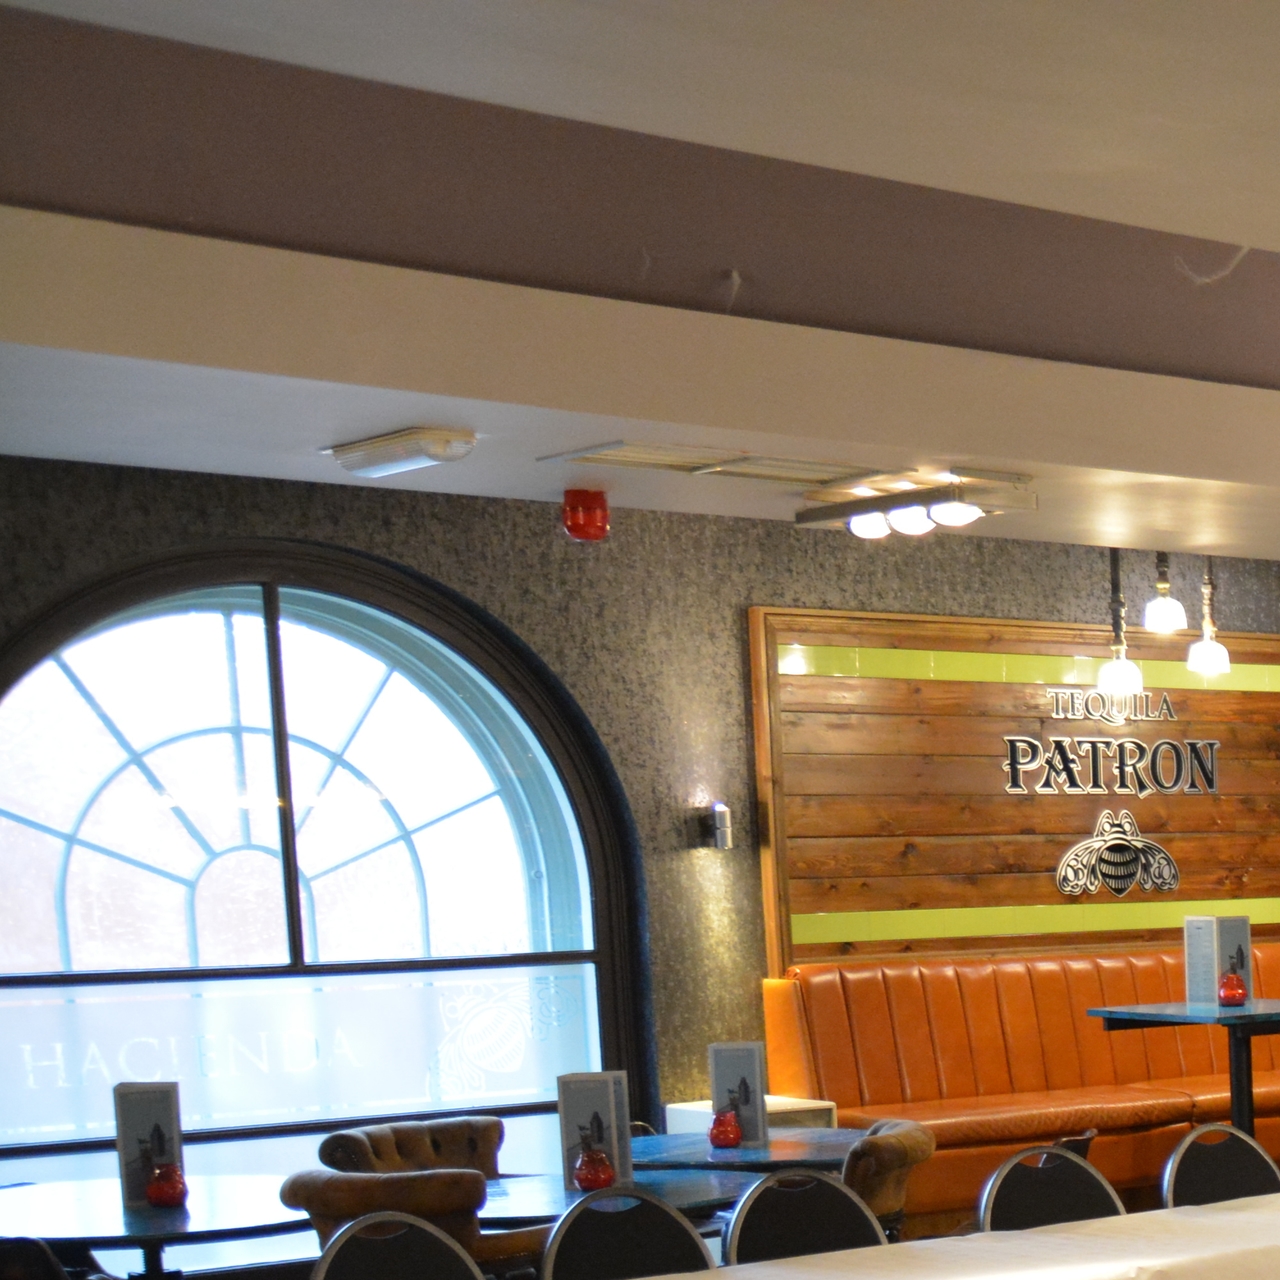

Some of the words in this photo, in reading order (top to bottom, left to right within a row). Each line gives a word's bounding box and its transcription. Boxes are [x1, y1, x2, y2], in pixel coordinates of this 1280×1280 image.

[1046, 688, 1177, 726] TEQUILA
[1002, 736, 1220, 799] PATRON
[19, 1026, 363, 1089] HACIENDA
